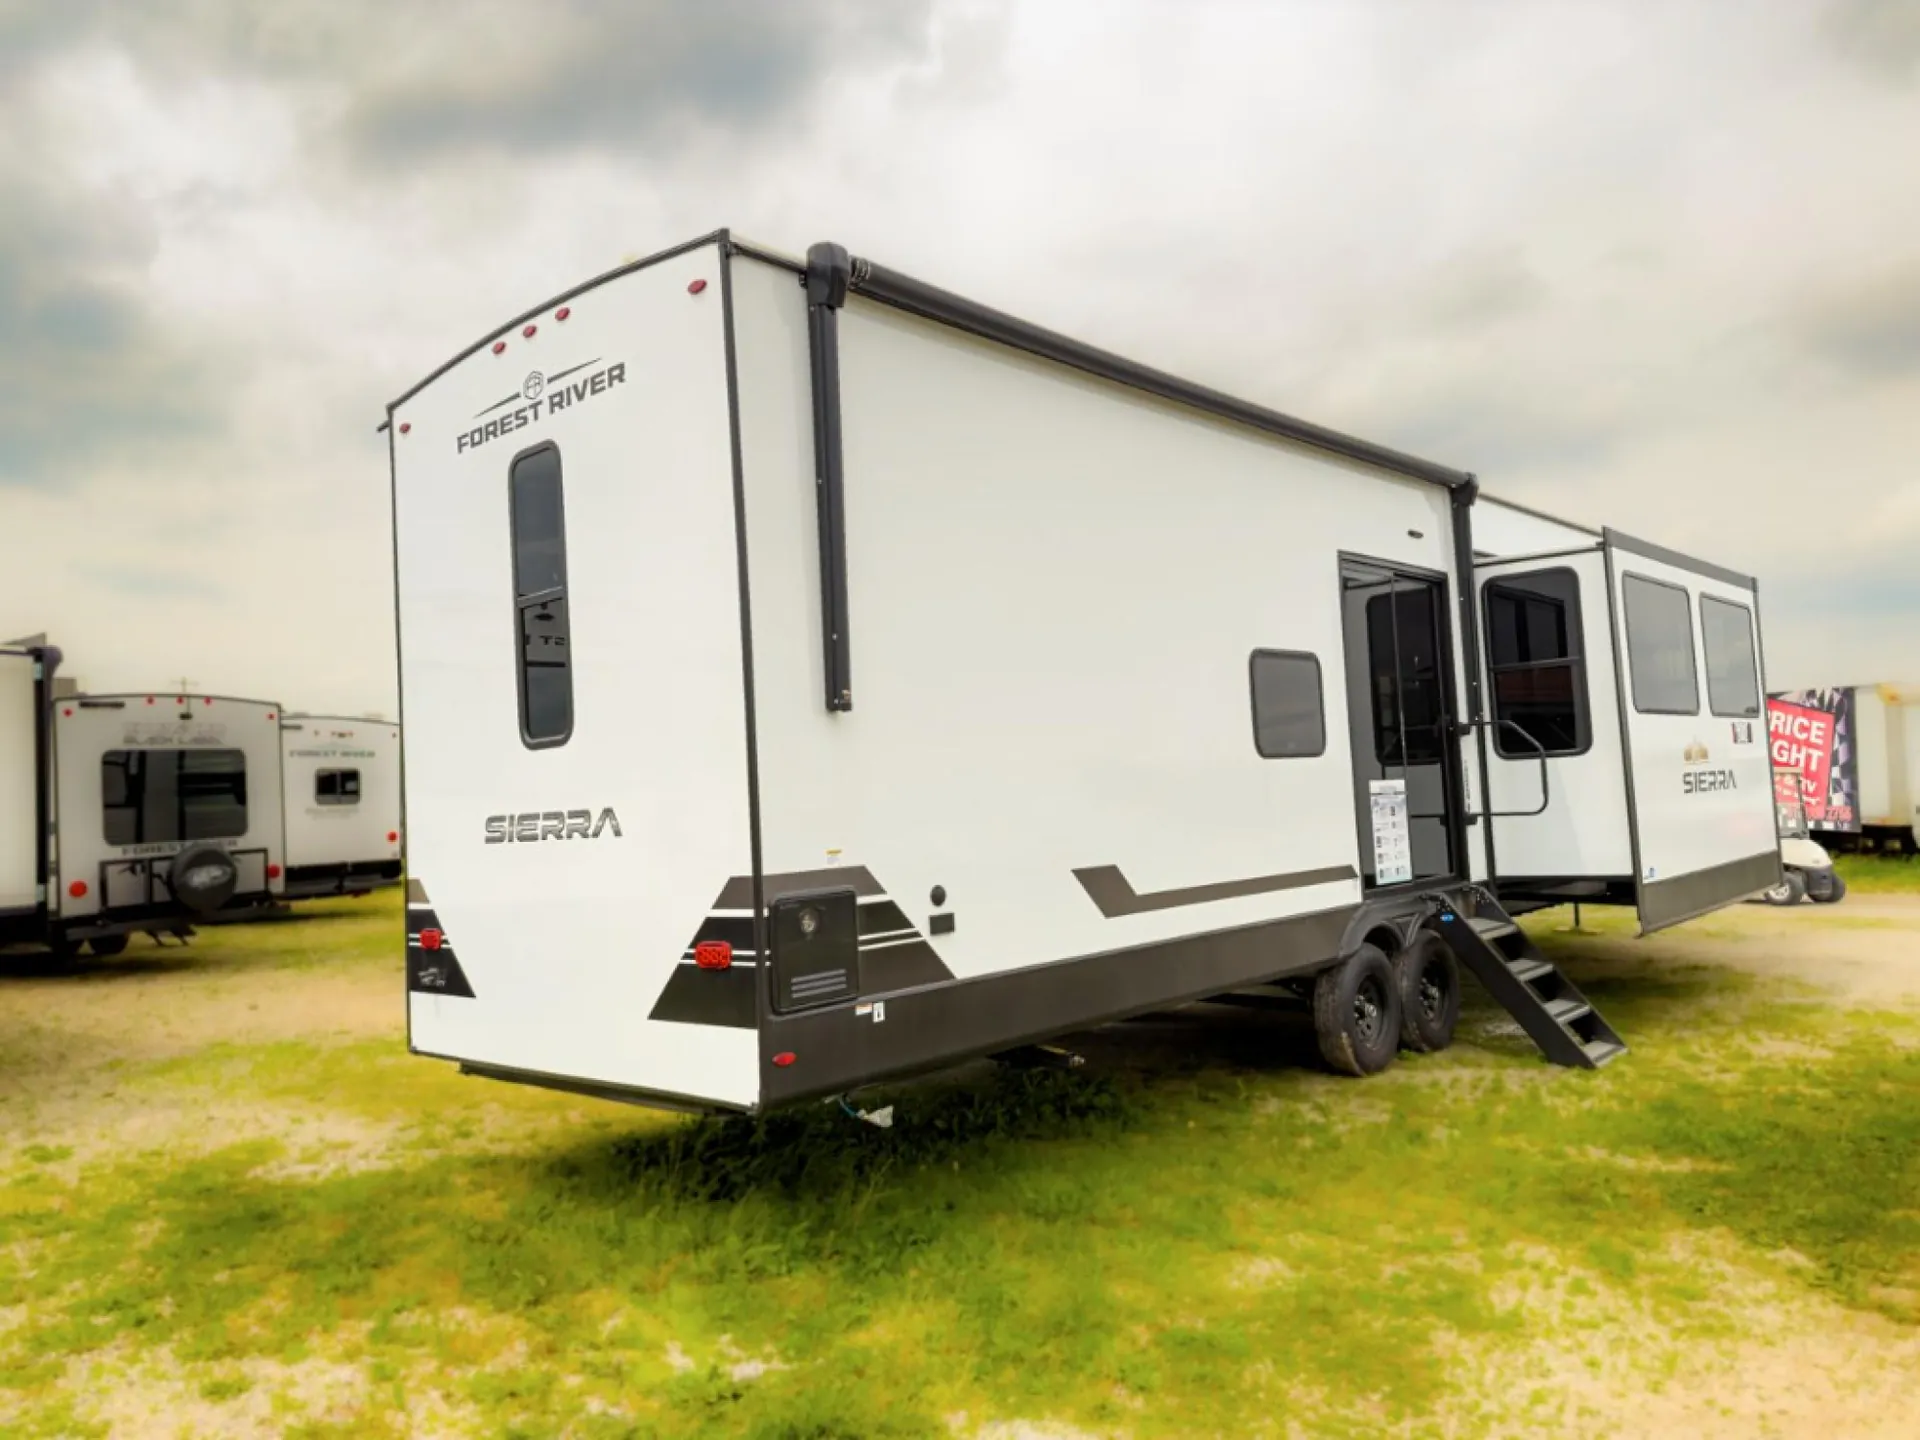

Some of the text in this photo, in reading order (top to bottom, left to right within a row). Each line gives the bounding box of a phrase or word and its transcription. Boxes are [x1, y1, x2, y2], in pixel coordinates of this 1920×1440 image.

[457, 361, 626, 454] FOREST RIVER
[1768, 708, 1826, 746] RICE
[1770, 737, 1825, 772] GHT
[1682, 769, 1738, 795] SIERRA
[484, 806, 623, 844] SIERRA
